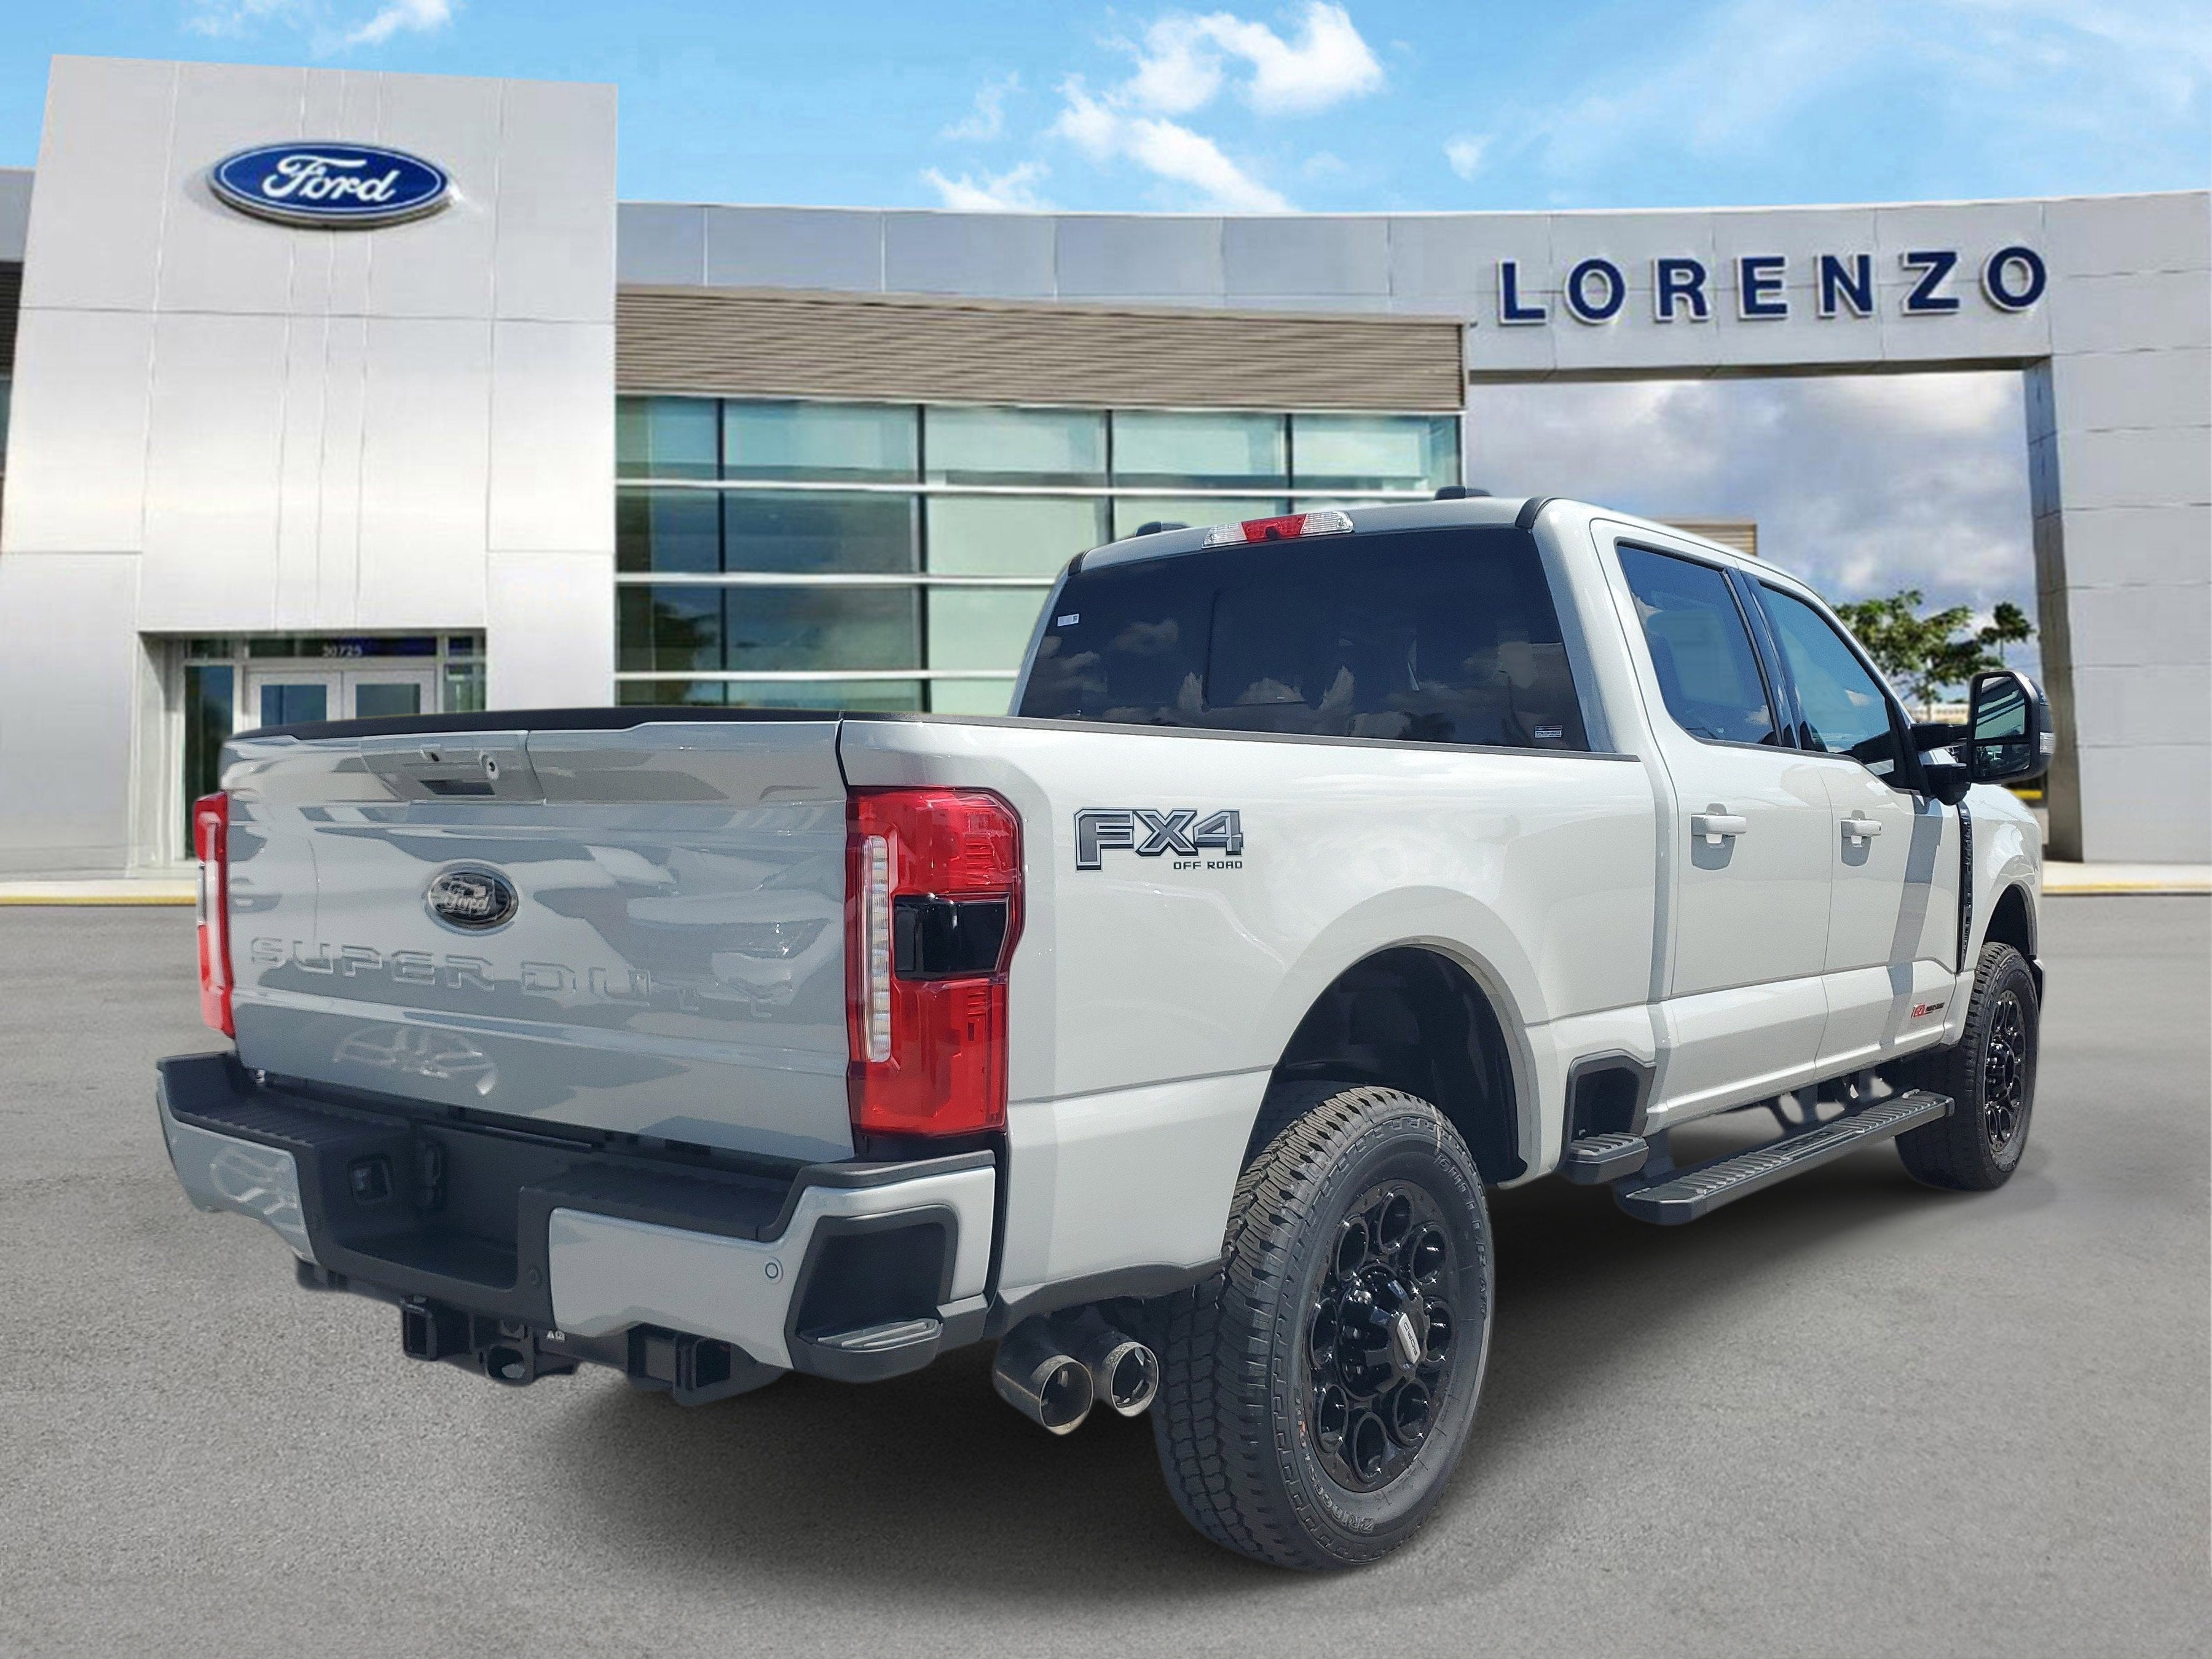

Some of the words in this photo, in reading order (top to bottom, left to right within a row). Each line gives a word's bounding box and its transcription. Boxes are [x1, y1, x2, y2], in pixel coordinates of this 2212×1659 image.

[262, 154, 401, 202] Ford
[1498, 246, 2047, 325] LORENZO
[1074, 807, 1243, 872] FX4
[1173, 861, 1202, 870] OFF
[1206, 861, 1243, 870] ROAD
[251, 937, 495, 992] SUPER
